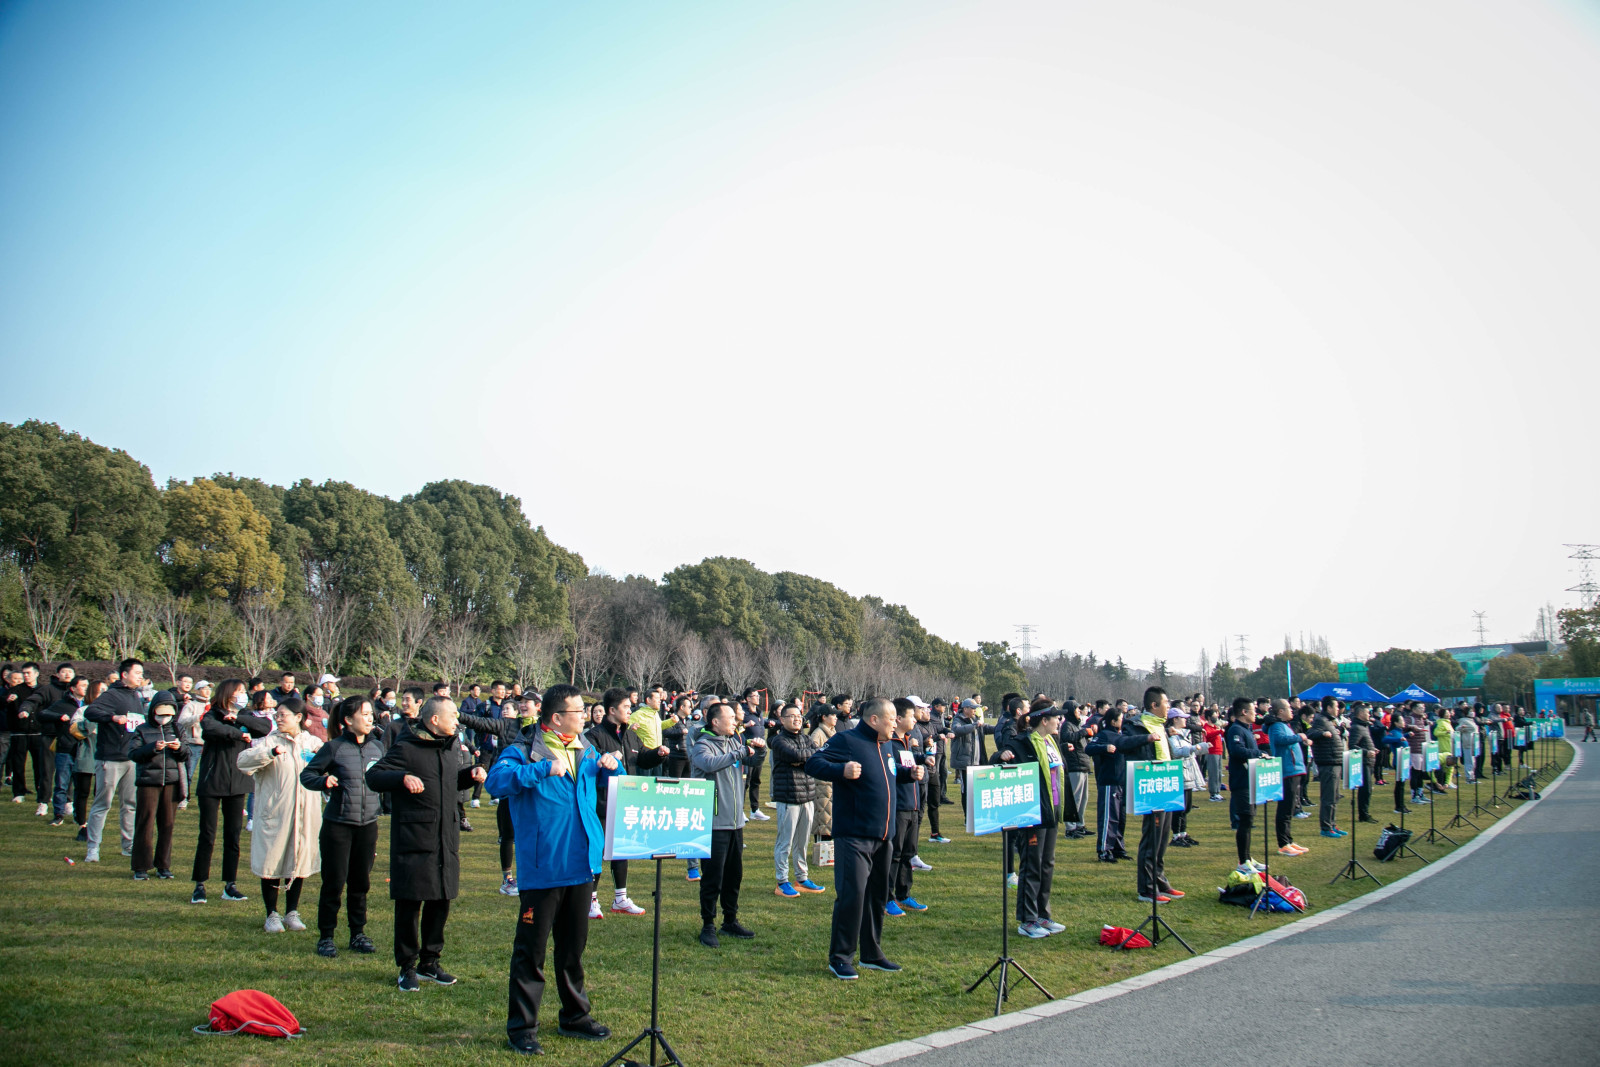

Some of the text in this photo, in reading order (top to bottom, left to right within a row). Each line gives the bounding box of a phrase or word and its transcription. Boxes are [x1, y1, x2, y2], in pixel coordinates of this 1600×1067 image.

[981, 783, 1035, 809] 昆高新集团
[1138, 776, 1180, 795] 行政审批局
[623, 804, 706, 831] 亭林办事处
